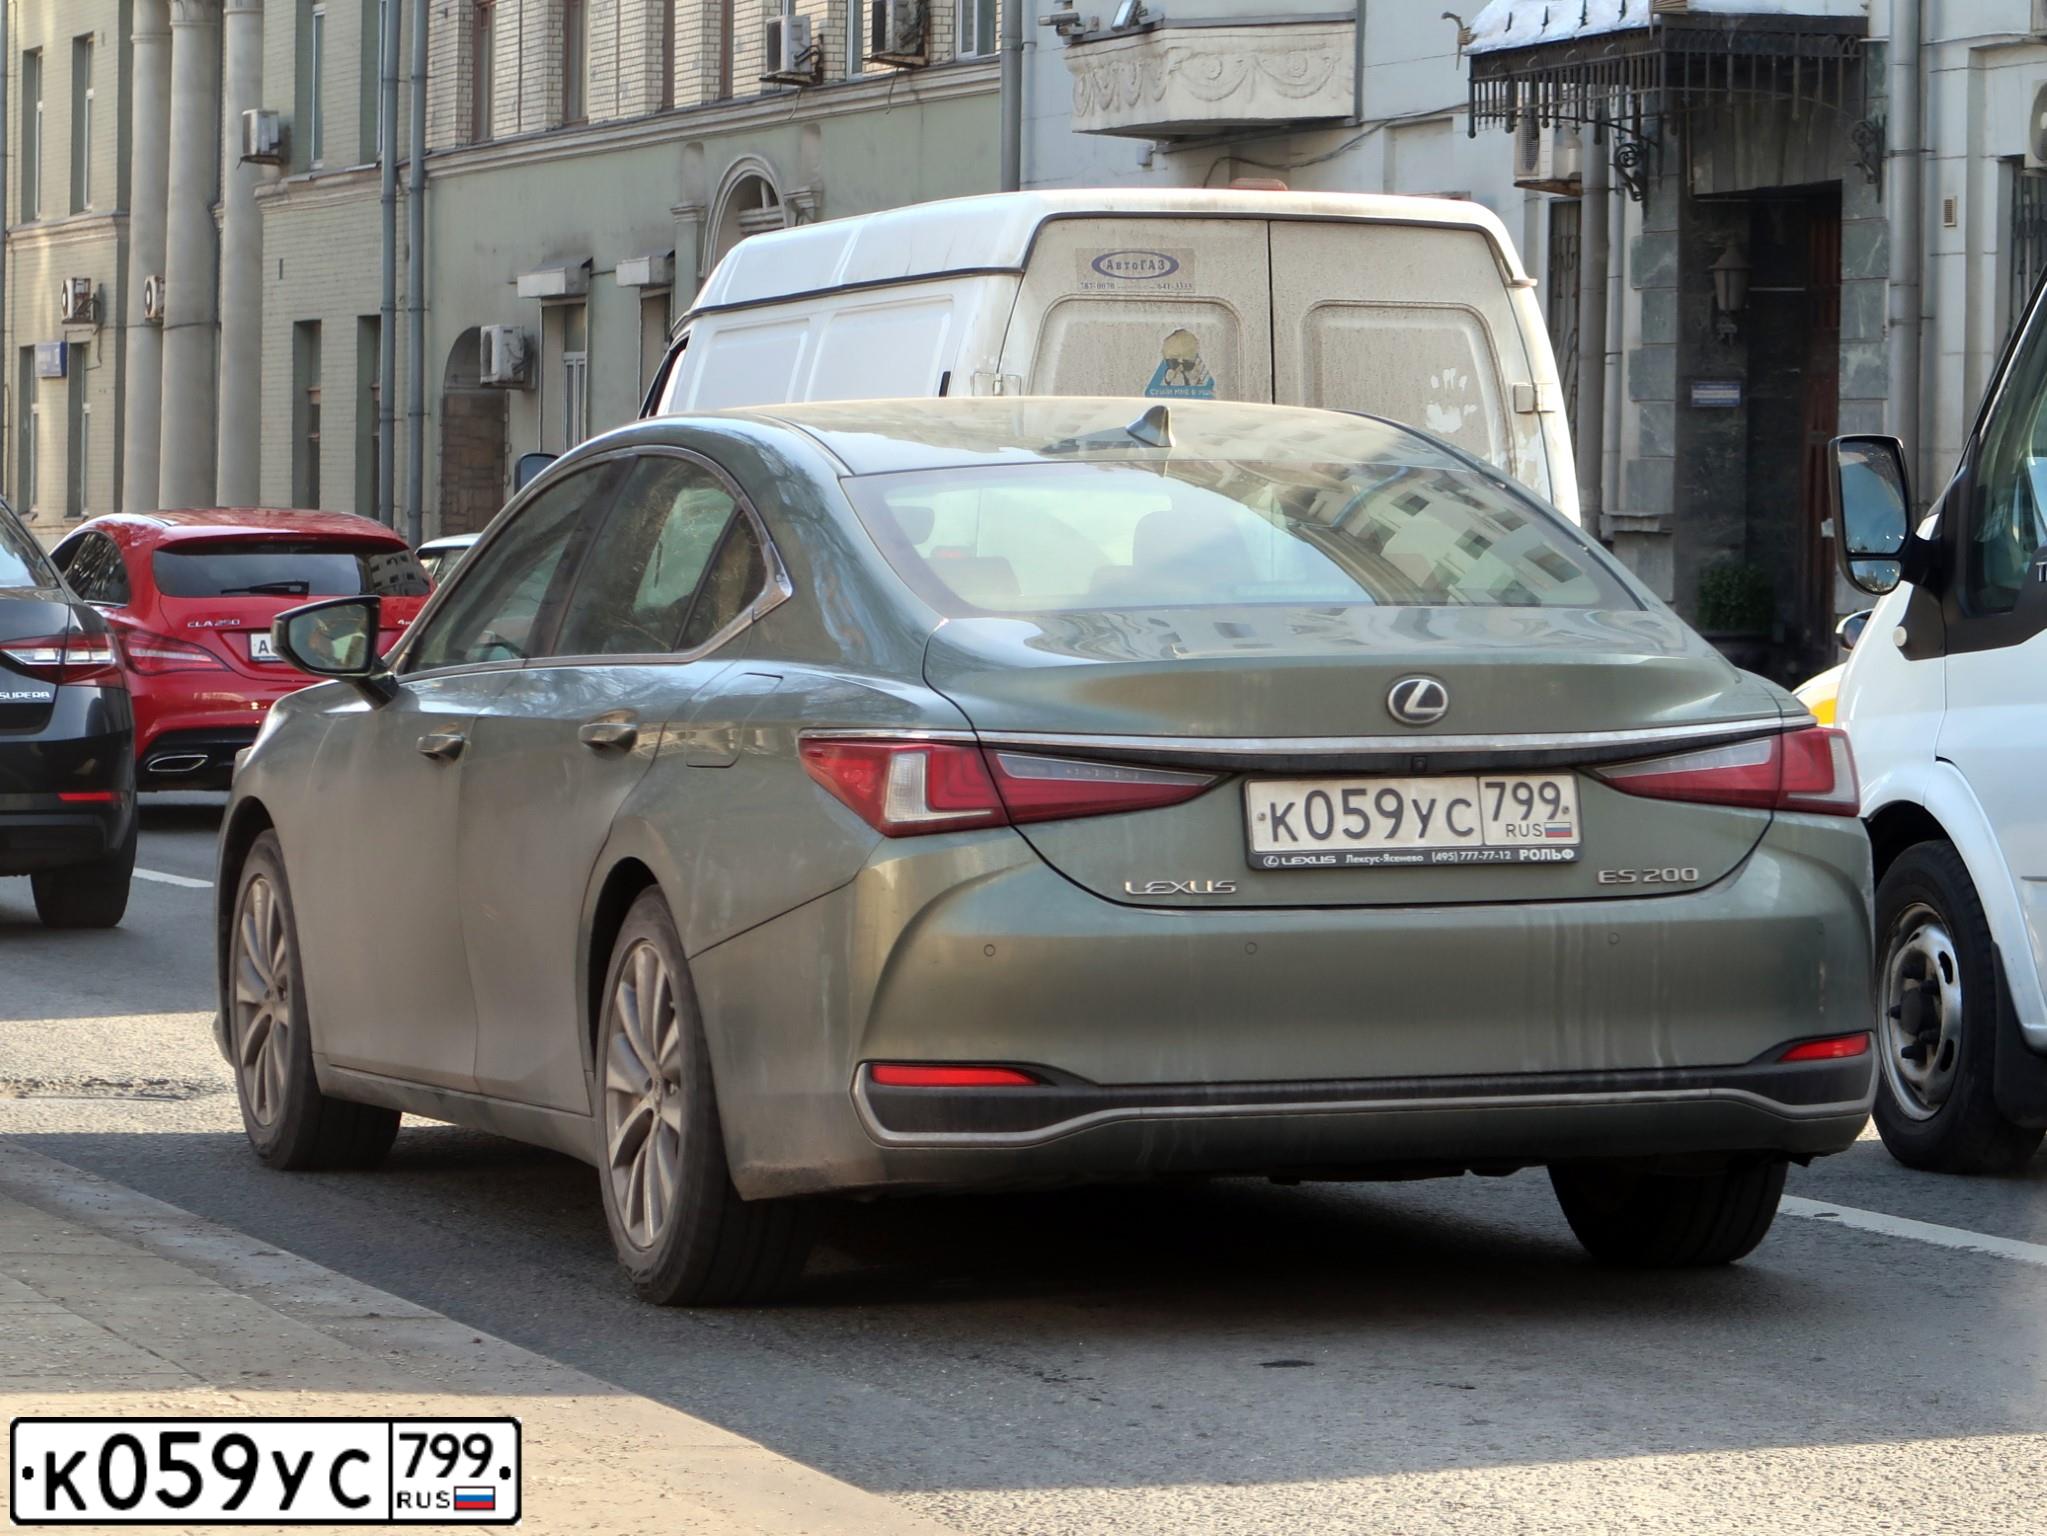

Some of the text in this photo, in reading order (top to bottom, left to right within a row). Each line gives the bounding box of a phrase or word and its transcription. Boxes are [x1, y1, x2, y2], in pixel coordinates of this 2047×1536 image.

[1105, 259, 1166, 271] АвтоГАЗ
[1484, 781, 1561, 822] 799
[1505, 823, 1543, 838] RUS
[1281, 855, 1337, 866] LEXUS
[1431, 851, 1458, 863] (495)
[1460, 850, 1512, 861] 777-77-12
[1519, 848, 1575, 861] РОЛЬФ
[1598, 867, 1699, 884] ES 200
[1124, 880, 1237, 895] LEXUS
